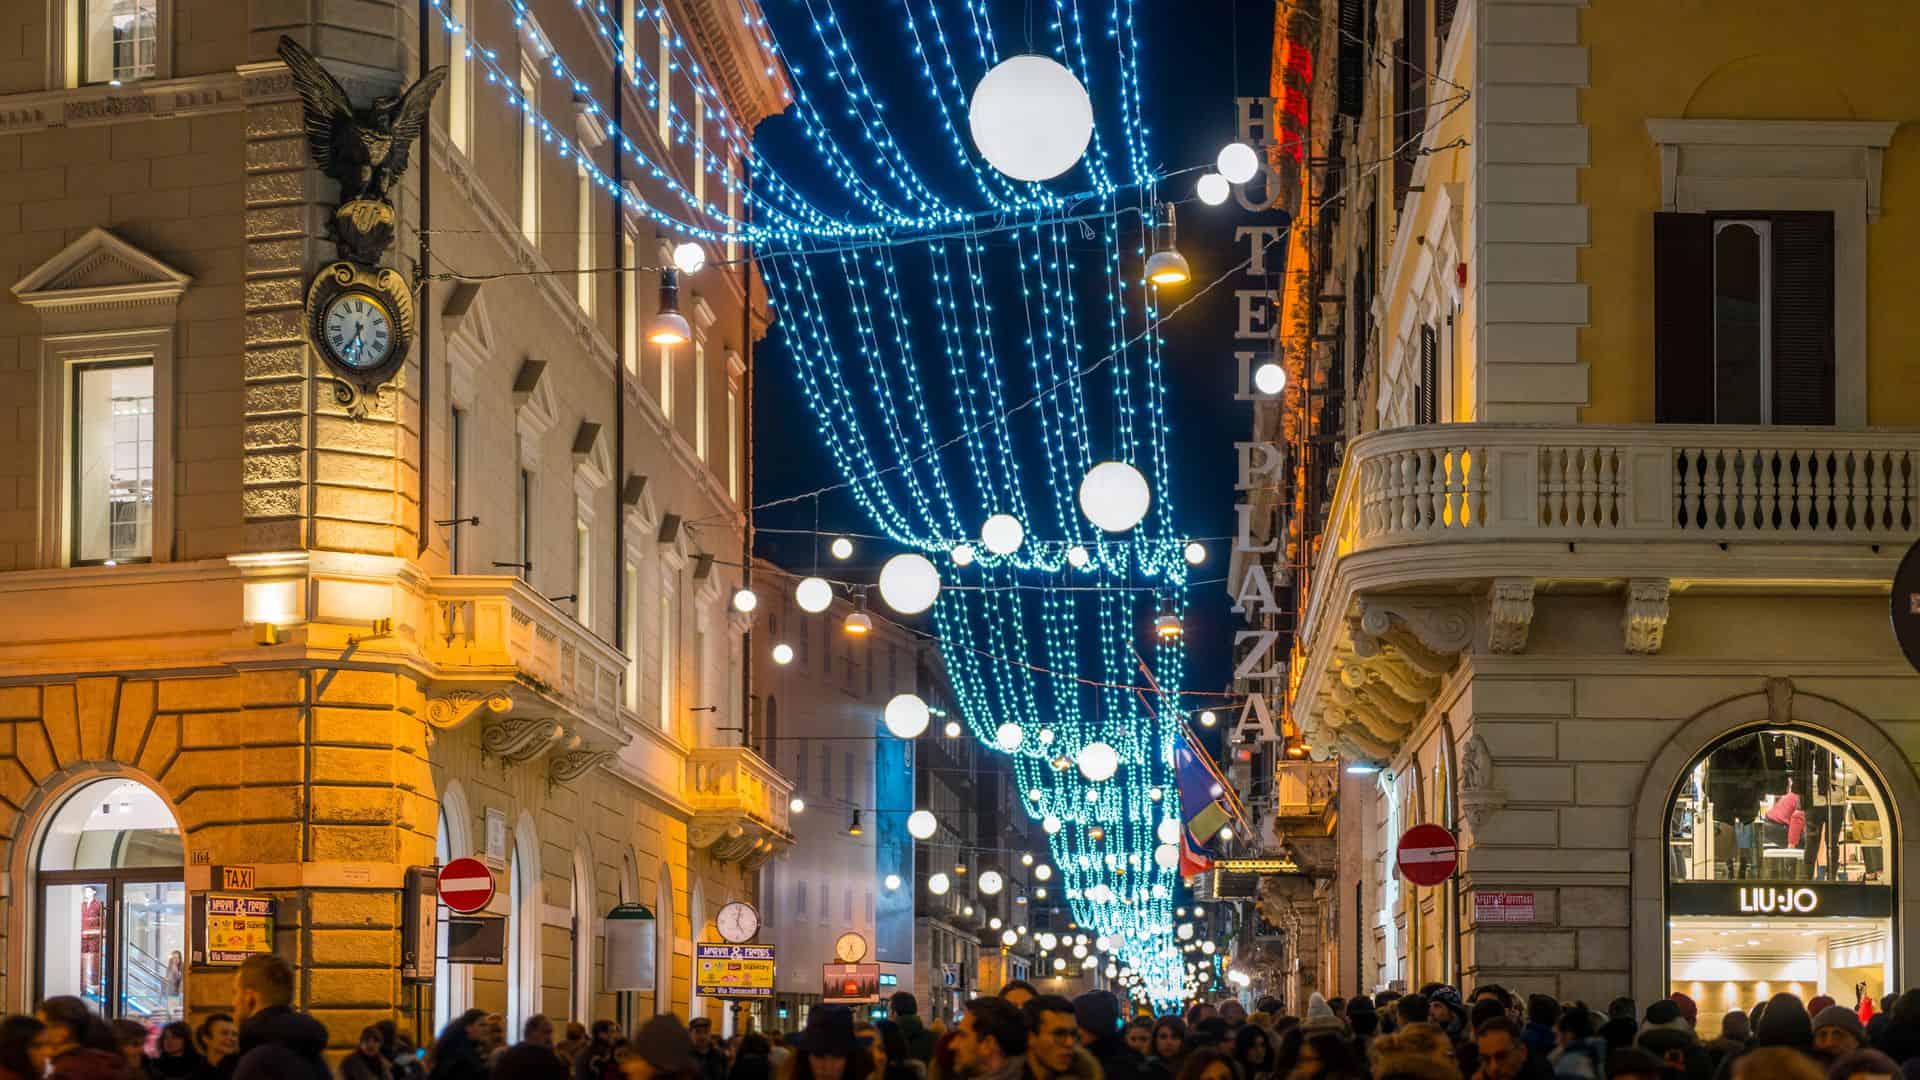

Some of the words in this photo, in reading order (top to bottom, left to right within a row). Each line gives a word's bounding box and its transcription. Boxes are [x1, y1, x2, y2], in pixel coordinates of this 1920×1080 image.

[1233, 96, 1288, 401] HOTEL
[1230, 441, 1283, 741] PLAZA
[225, 869, 252, 889] TAXI
